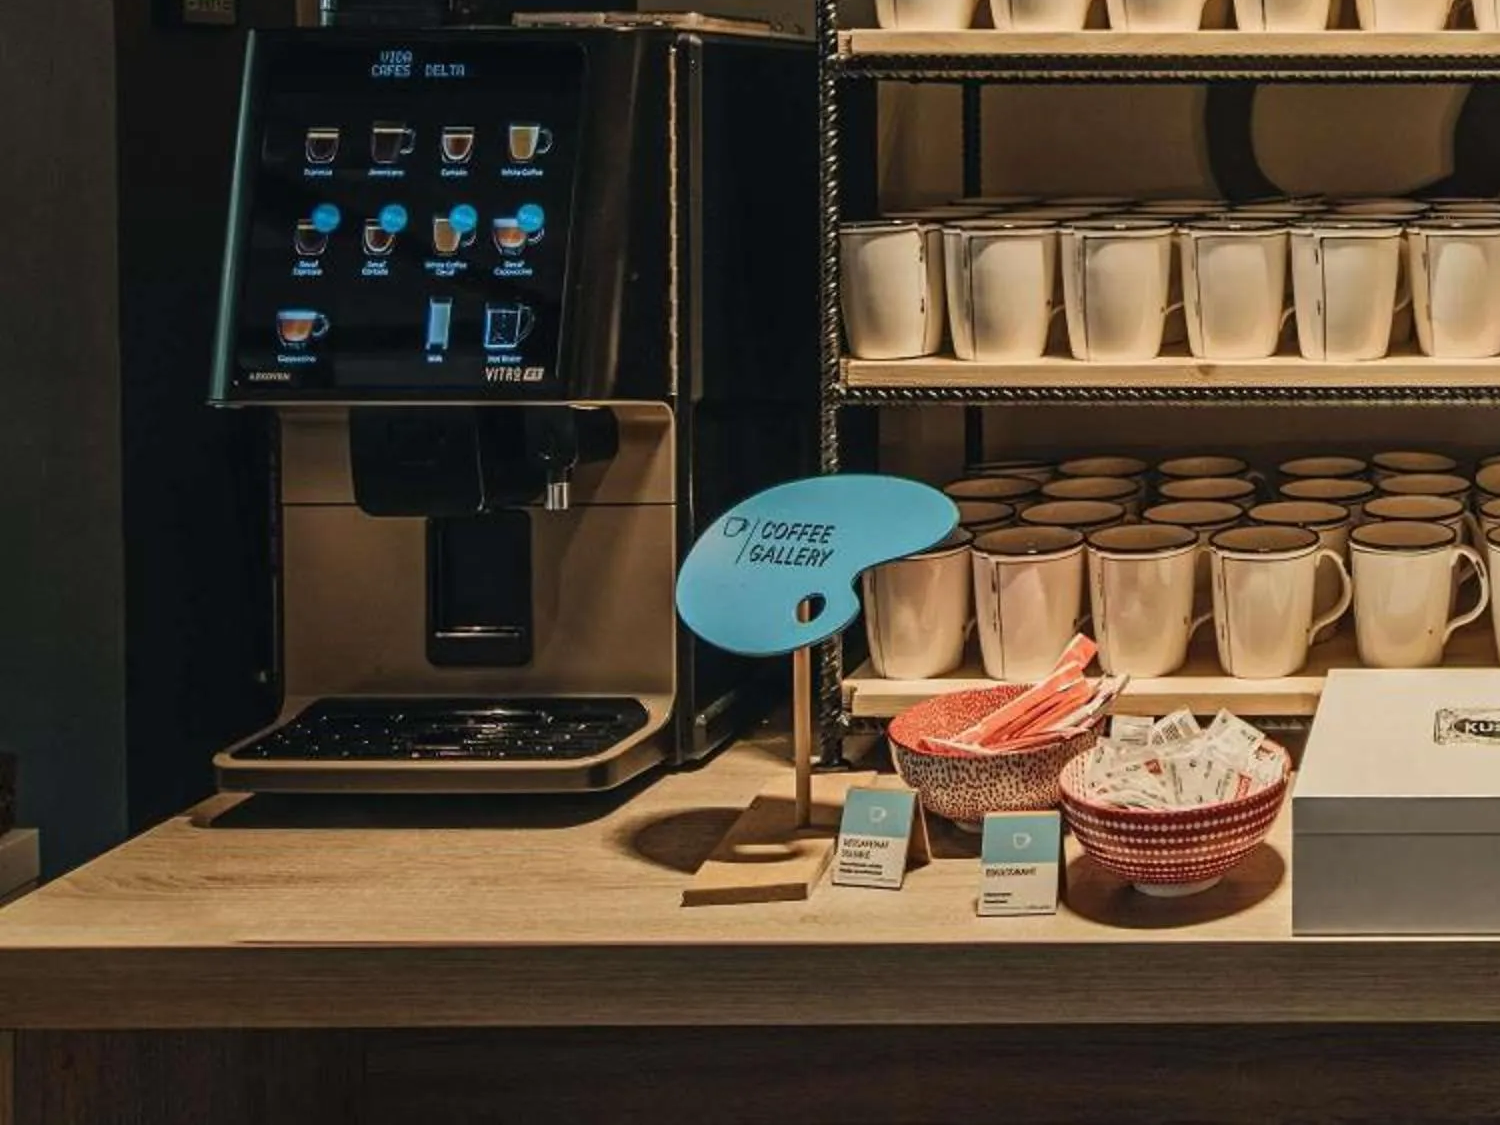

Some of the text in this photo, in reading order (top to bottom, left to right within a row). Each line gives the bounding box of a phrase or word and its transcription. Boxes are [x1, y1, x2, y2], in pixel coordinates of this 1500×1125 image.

[371, 64, 466, 77] CAFES DELTA
[761, 520, 836, 544] COFFEE
[749, 544, 835, 568] GALLERY
